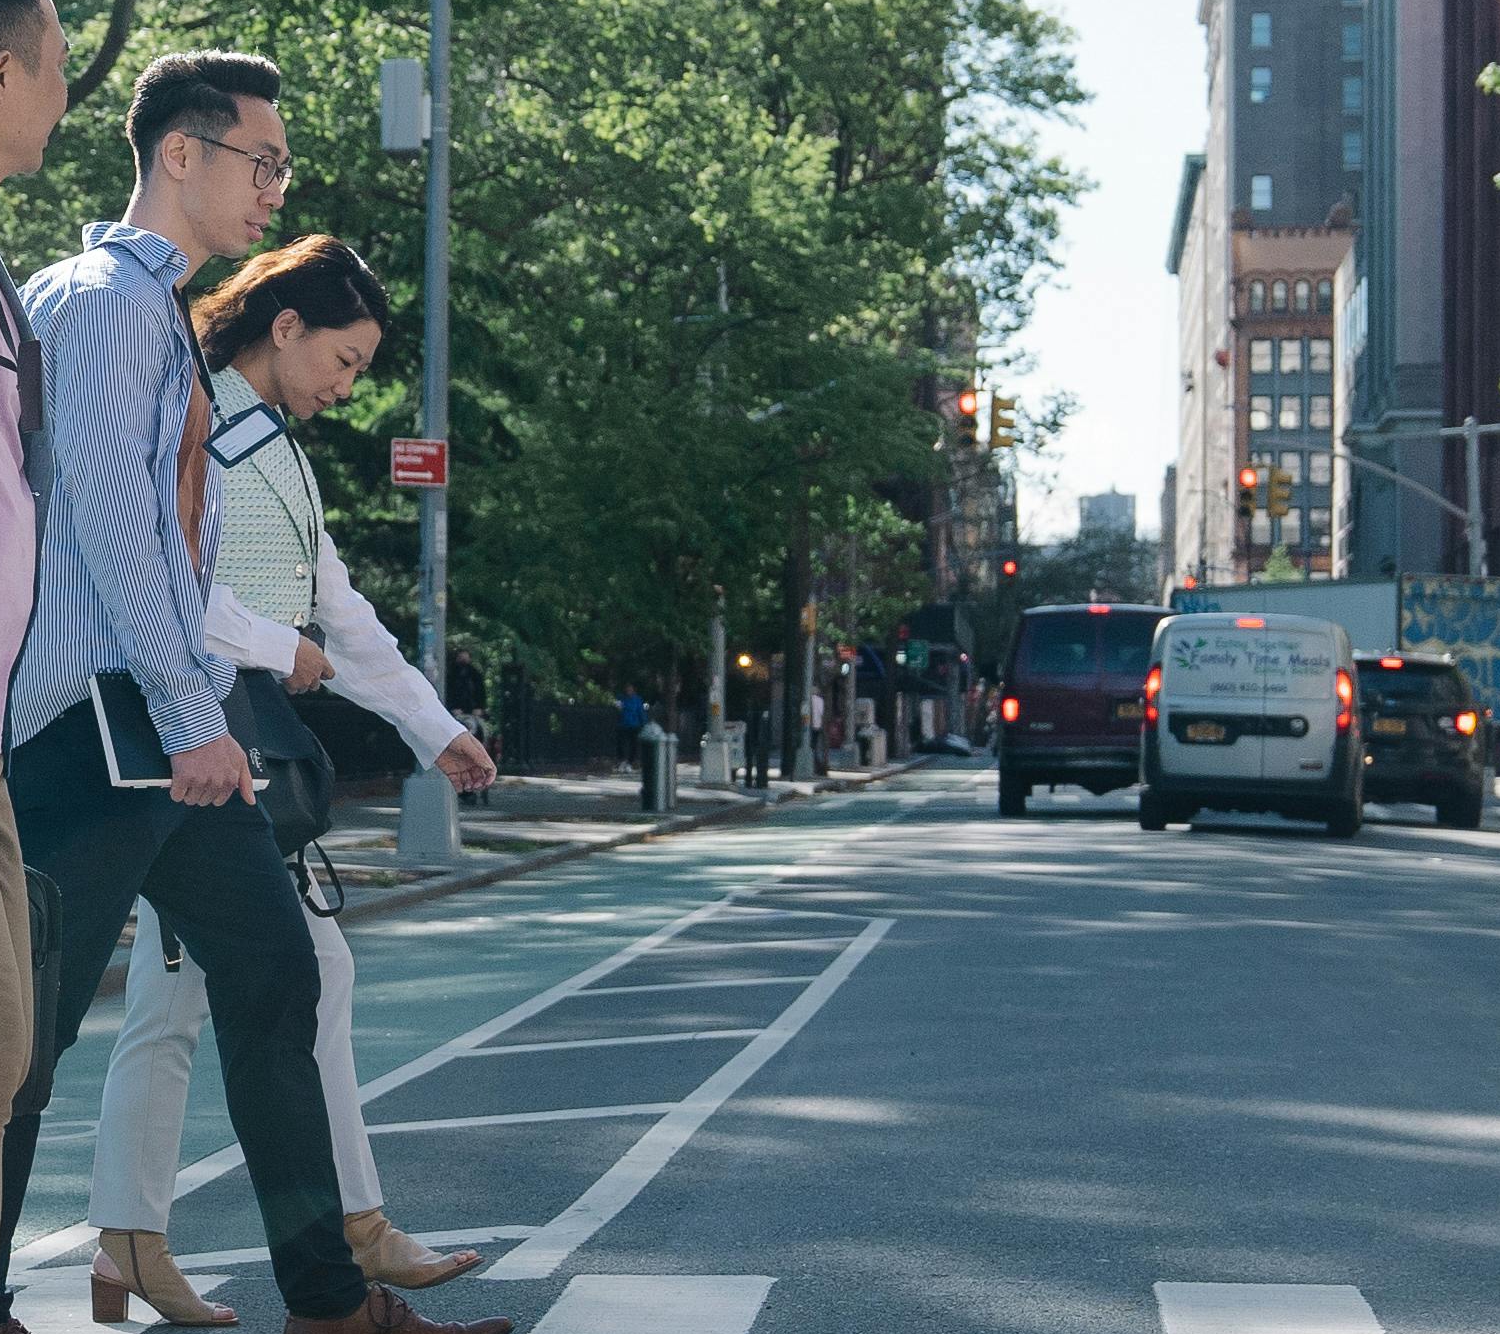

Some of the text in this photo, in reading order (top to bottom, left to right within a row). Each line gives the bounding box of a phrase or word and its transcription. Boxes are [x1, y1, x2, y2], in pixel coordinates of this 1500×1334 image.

[1190, 650, 1331, 667] Family Time Meals
